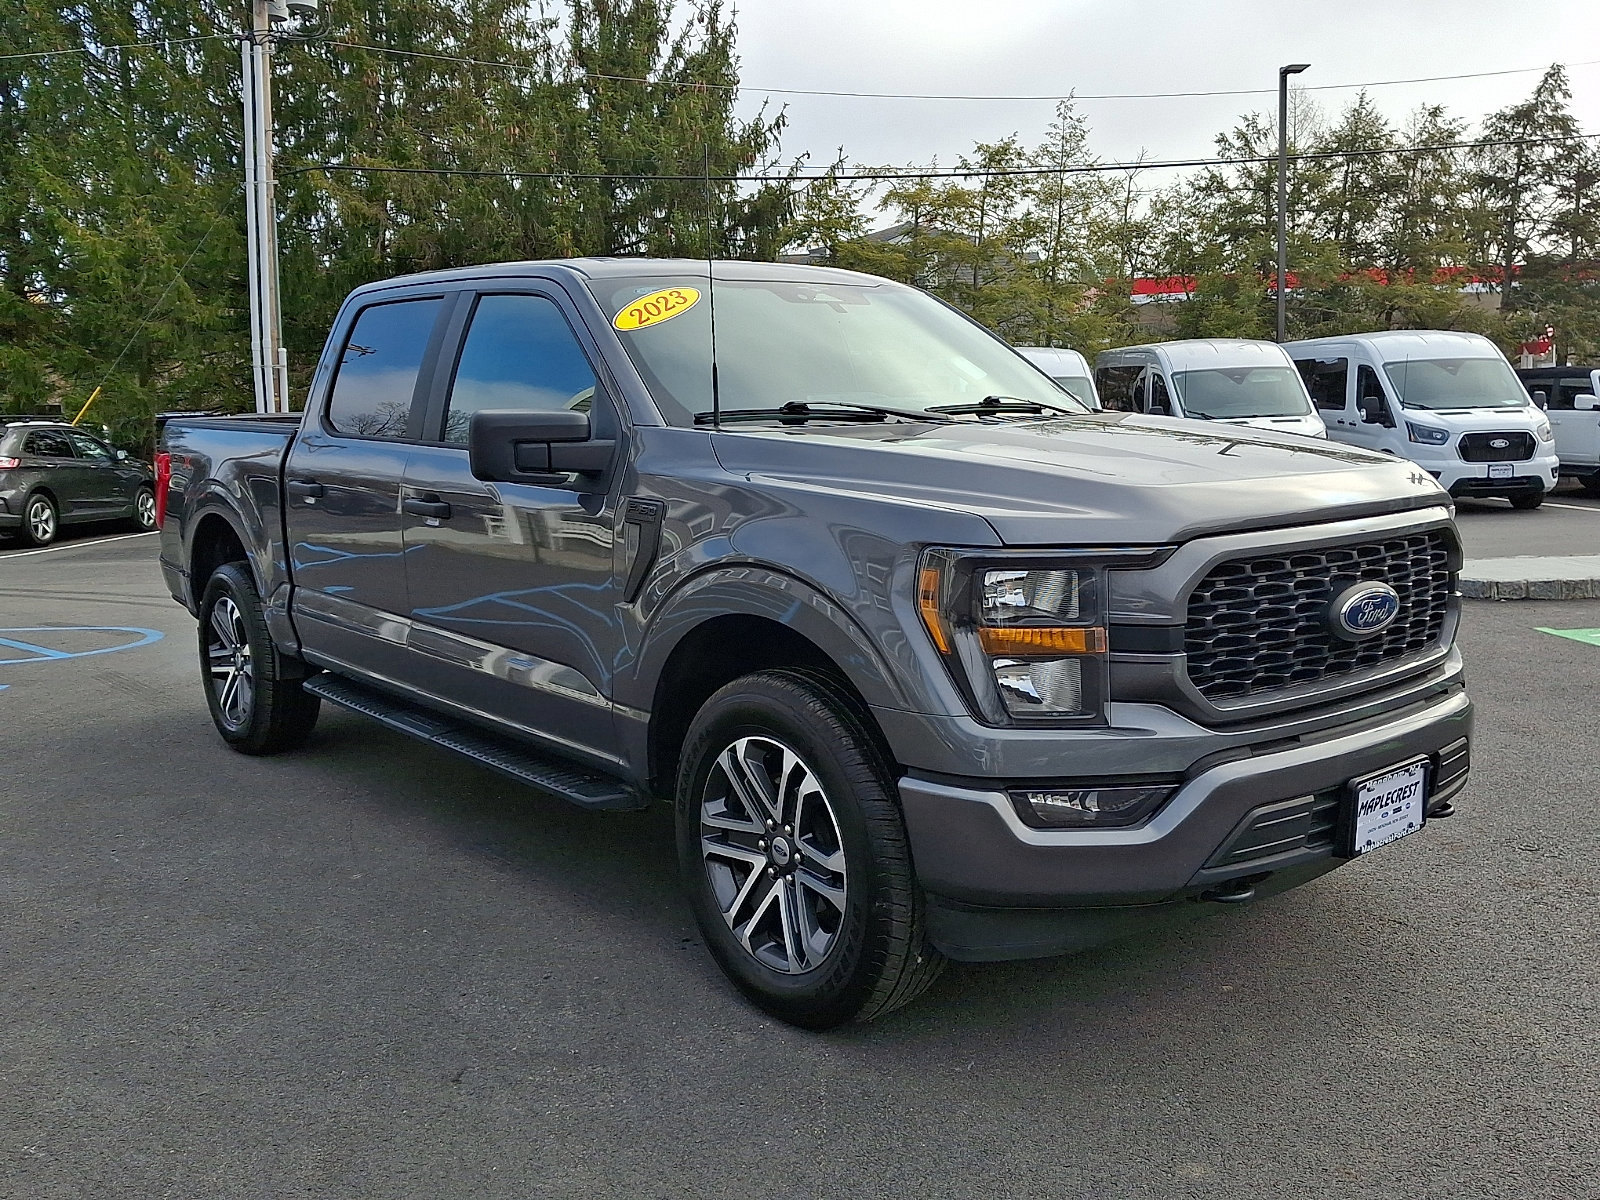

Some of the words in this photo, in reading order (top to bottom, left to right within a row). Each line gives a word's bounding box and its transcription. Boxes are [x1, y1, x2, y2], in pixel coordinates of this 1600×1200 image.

[629, 290, 688, 325] 2023
[1357, 598, 1389, 628] Ford
[1358, 781, 1420, 818] MAPLECREST
[1361, 824, 1421, 854] MaplecrestFord.com
